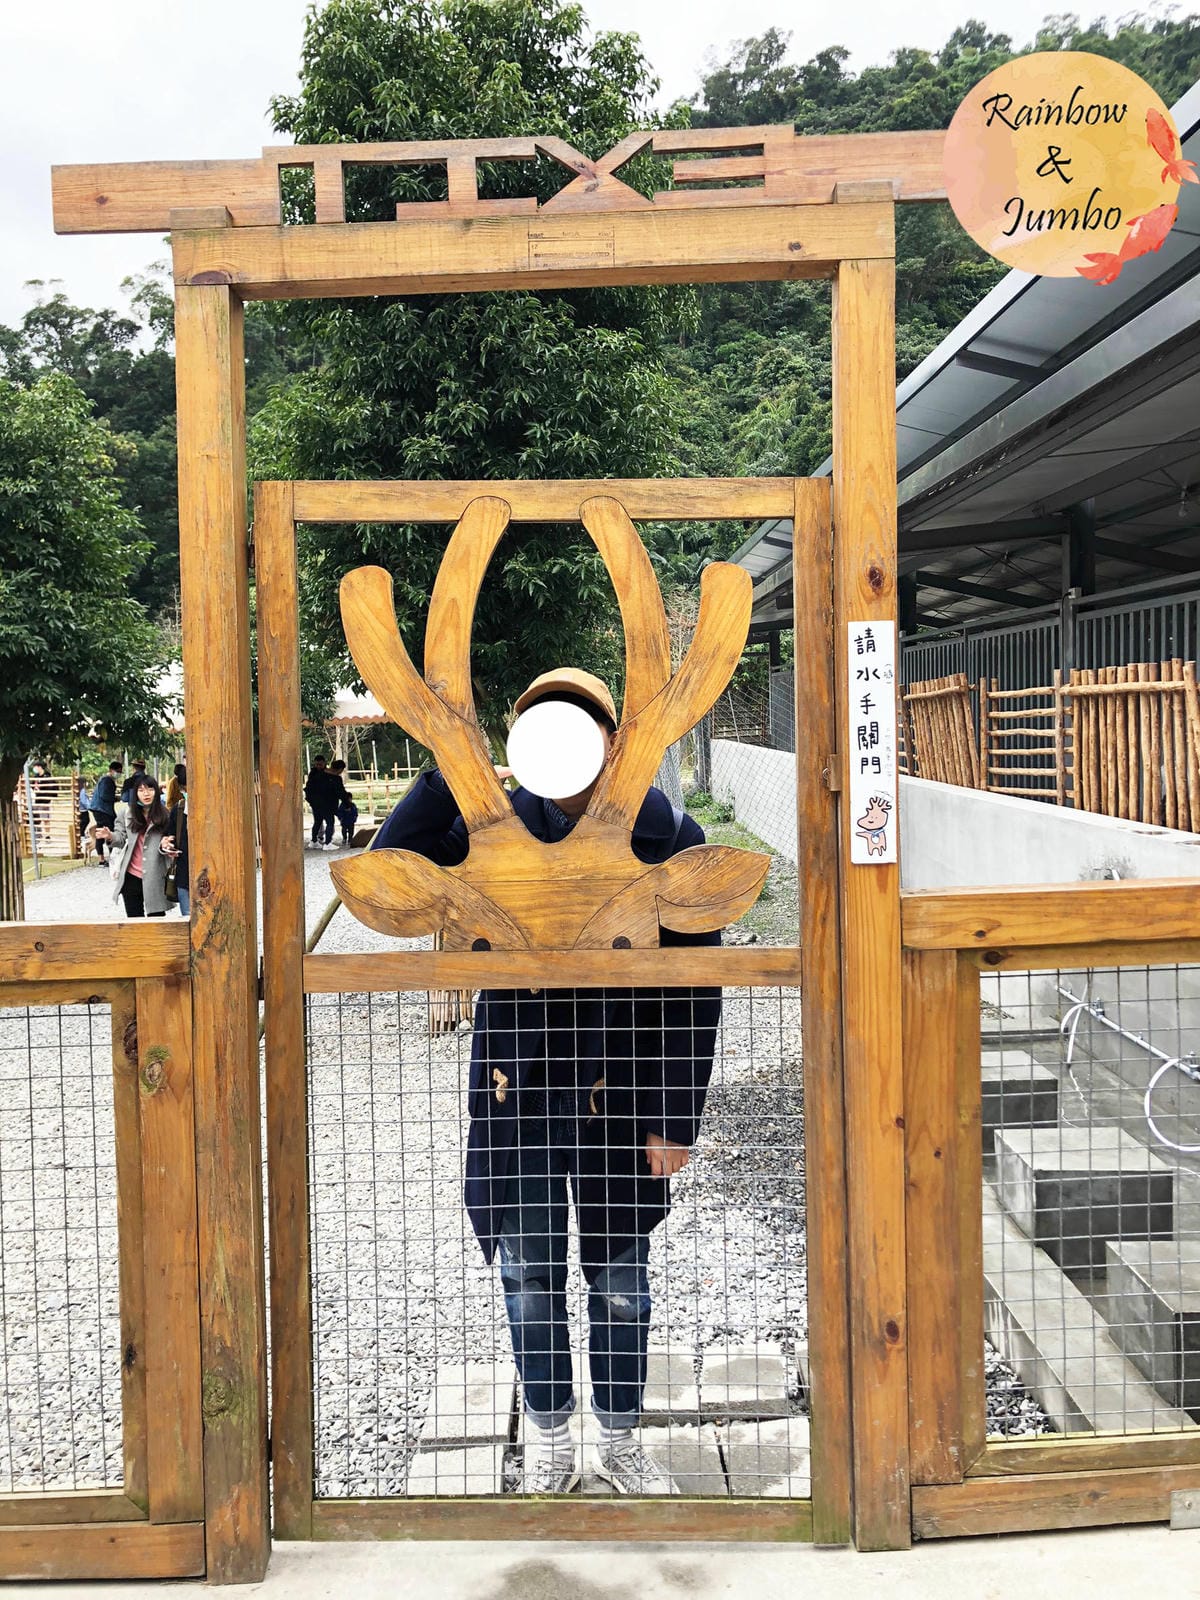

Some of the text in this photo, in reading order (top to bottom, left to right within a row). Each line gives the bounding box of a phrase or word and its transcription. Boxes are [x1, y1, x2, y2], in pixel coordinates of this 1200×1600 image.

[853, 627, 881, 775] 請水手關門
